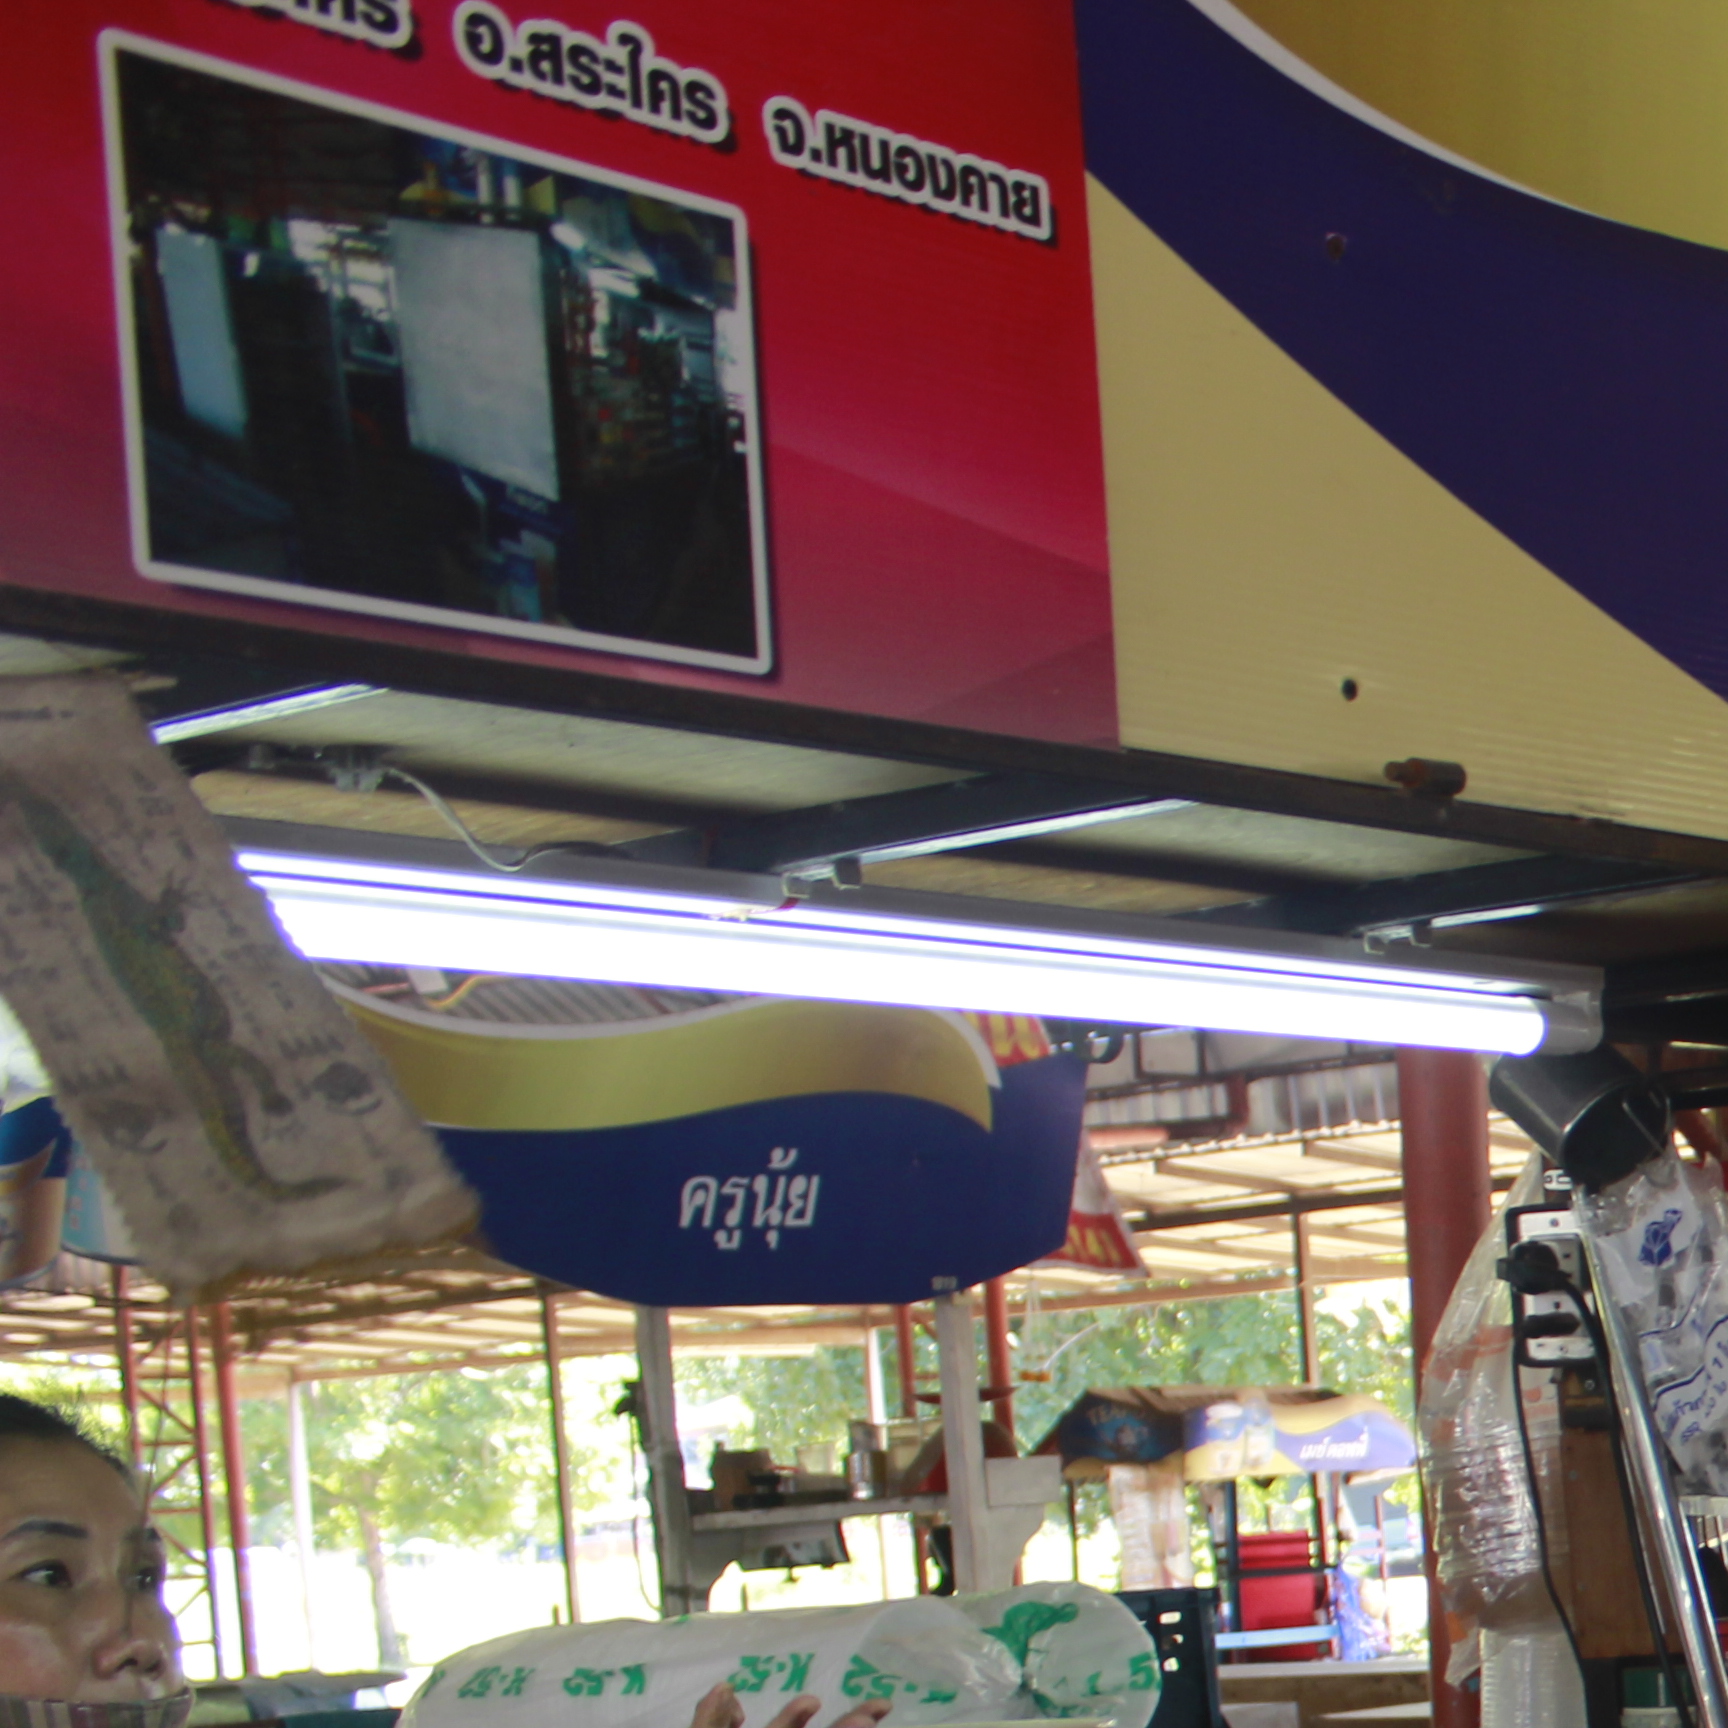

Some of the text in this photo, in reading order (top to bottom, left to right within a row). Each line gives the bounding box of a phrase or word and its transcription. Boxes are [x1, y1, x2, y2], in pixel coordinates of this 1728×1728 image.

[462, 10, 1044, 229] อ.สระใคร จ.หนองคาย
[678, 1147, 820, 1250] ครูนุ้ย
